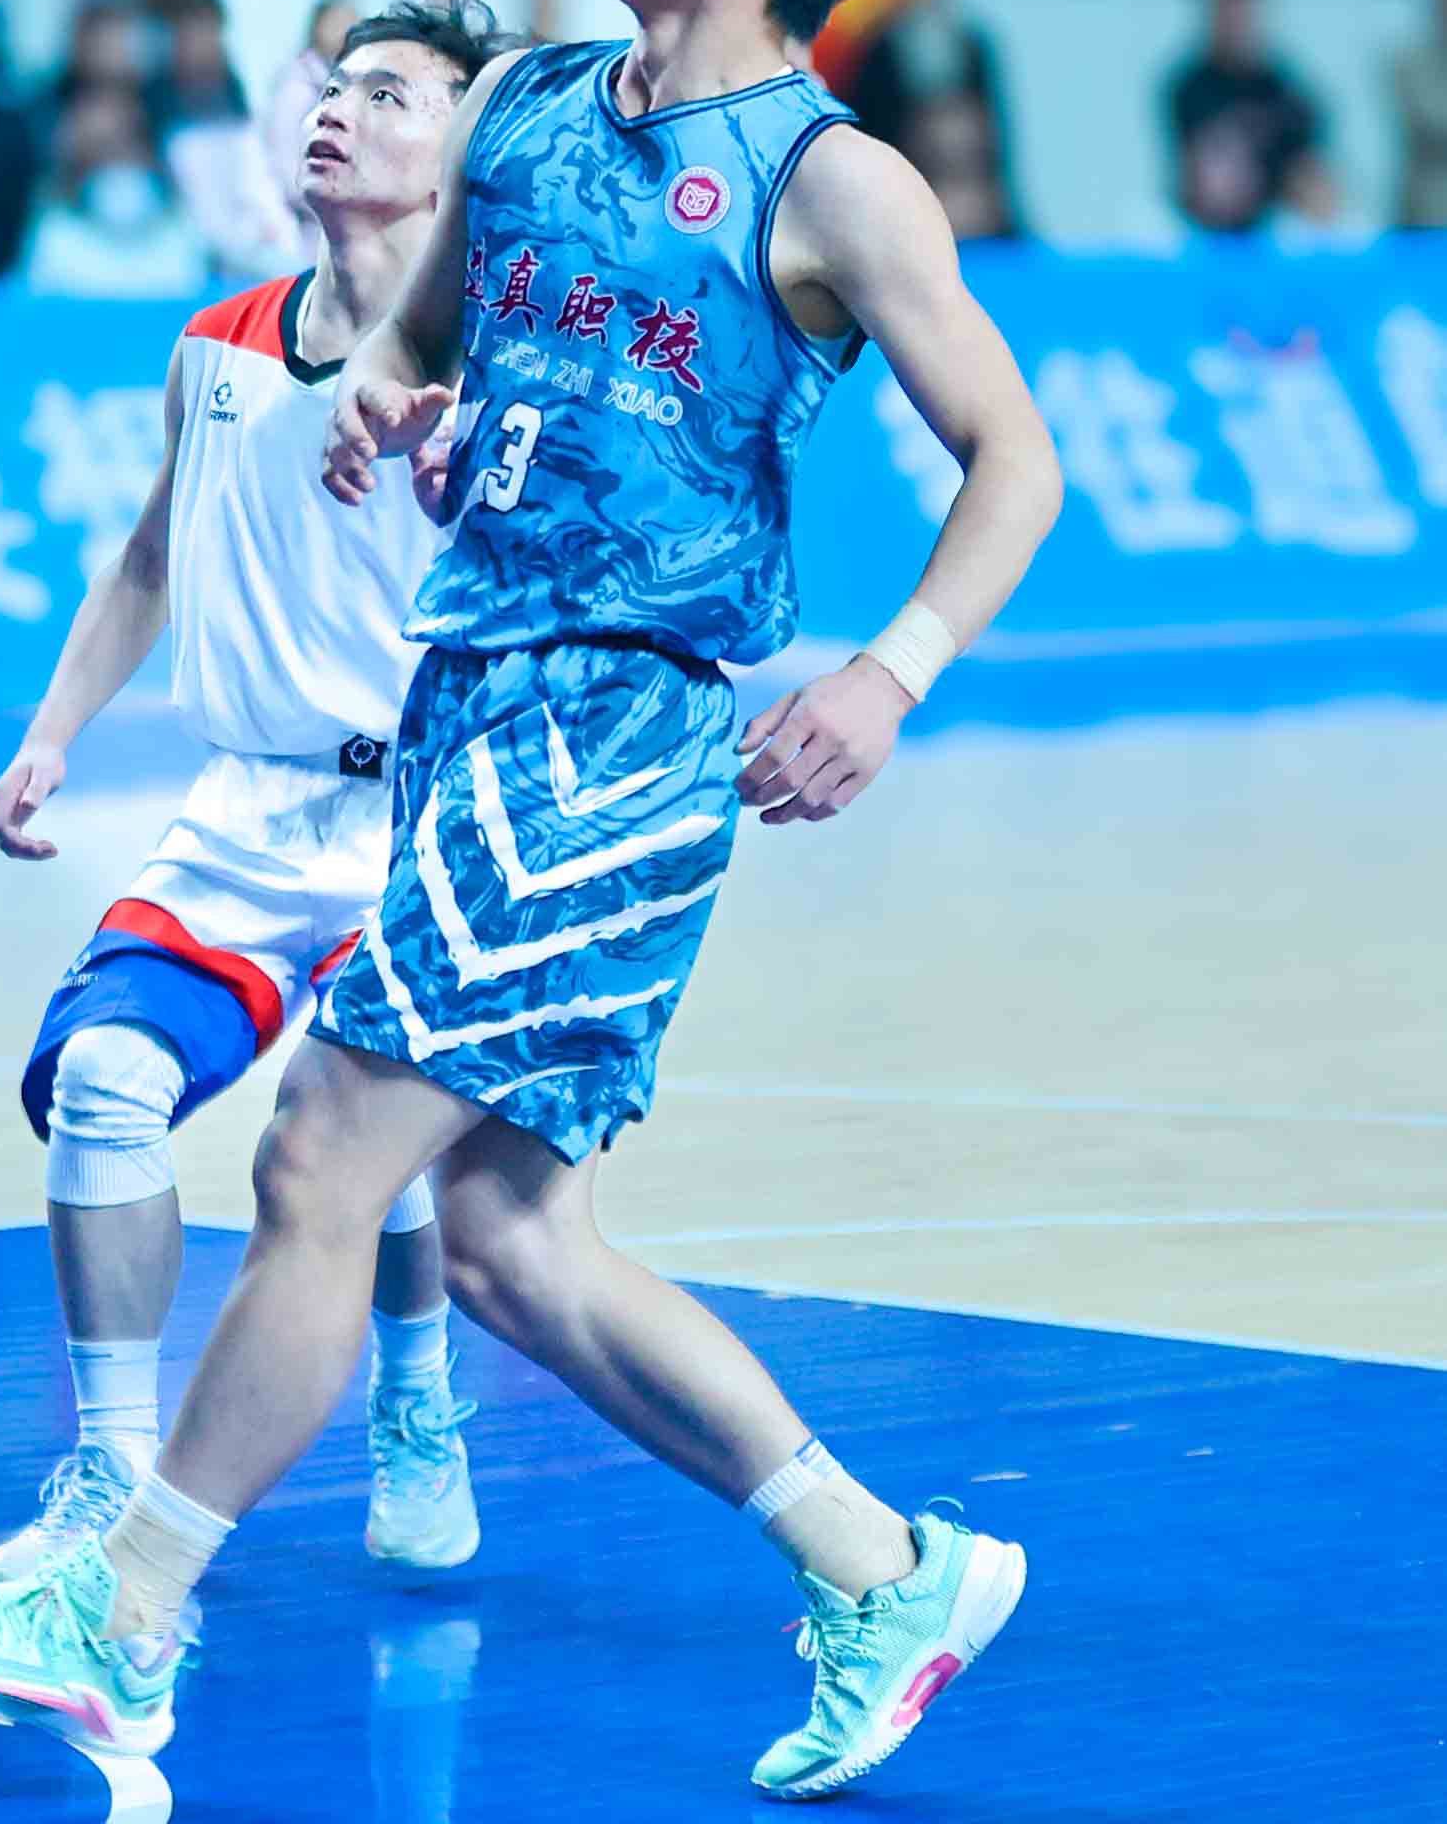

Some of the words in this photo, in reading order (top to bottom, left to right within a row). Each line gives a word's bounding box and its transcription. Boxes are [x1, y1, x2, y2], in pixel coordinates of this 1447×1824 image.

[492, 335, 551, 380] ZHEN
[551, 359, 595, 398] ZHI
[603, 376, 684, 427] XIAO
[484, 402, 545, 513] 3
